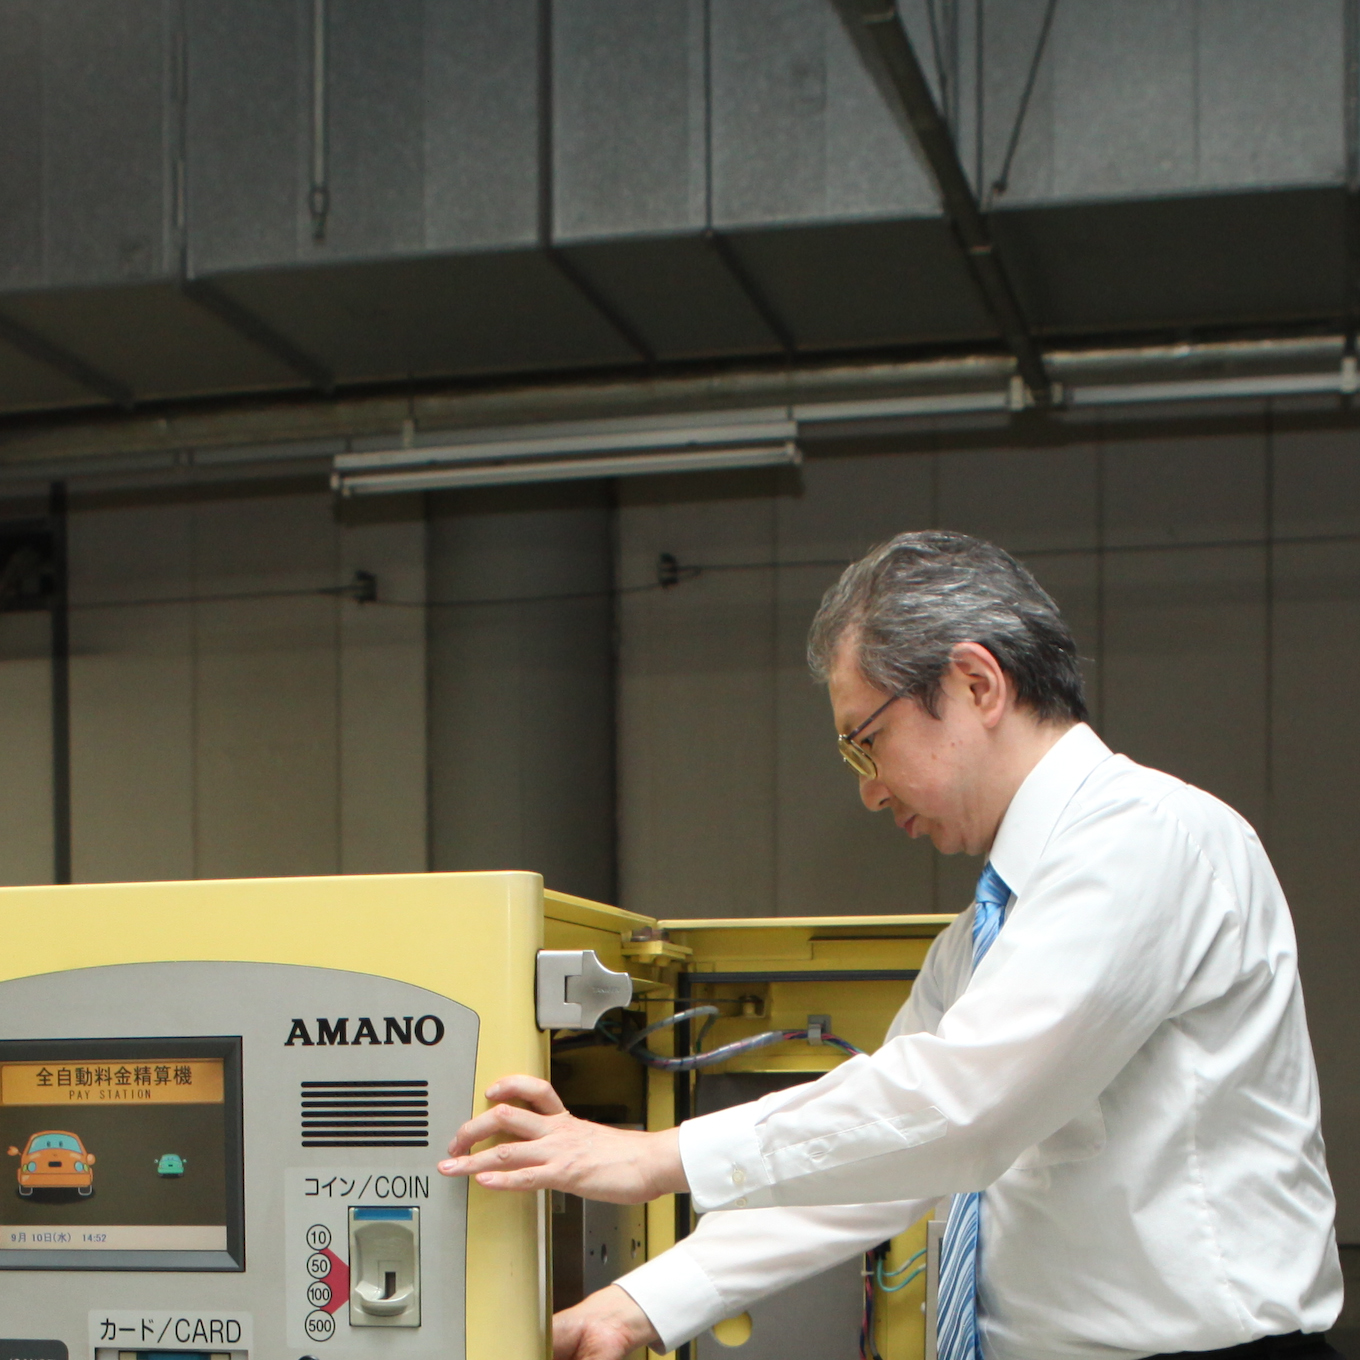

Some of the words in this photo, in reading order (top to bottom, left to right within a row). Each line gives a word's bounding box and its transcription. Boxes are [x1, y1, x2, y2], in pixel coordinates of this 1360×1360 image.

[284, 1015, 445, 1046] AMANO
[36, 1065, 193, 1087] 全自動料金精算機
[69, 1089, 90, 1100] PAY
[99, 1089, 151, 1099] STATION
[82, 1233, 107, 1243] 14:52
[311, 1231, 326, 1245] 10
[311, 1259, 328, 1273] 50
[310, 1288, 330, 1301] 100
[308, 1319, 332, 1333] 500
